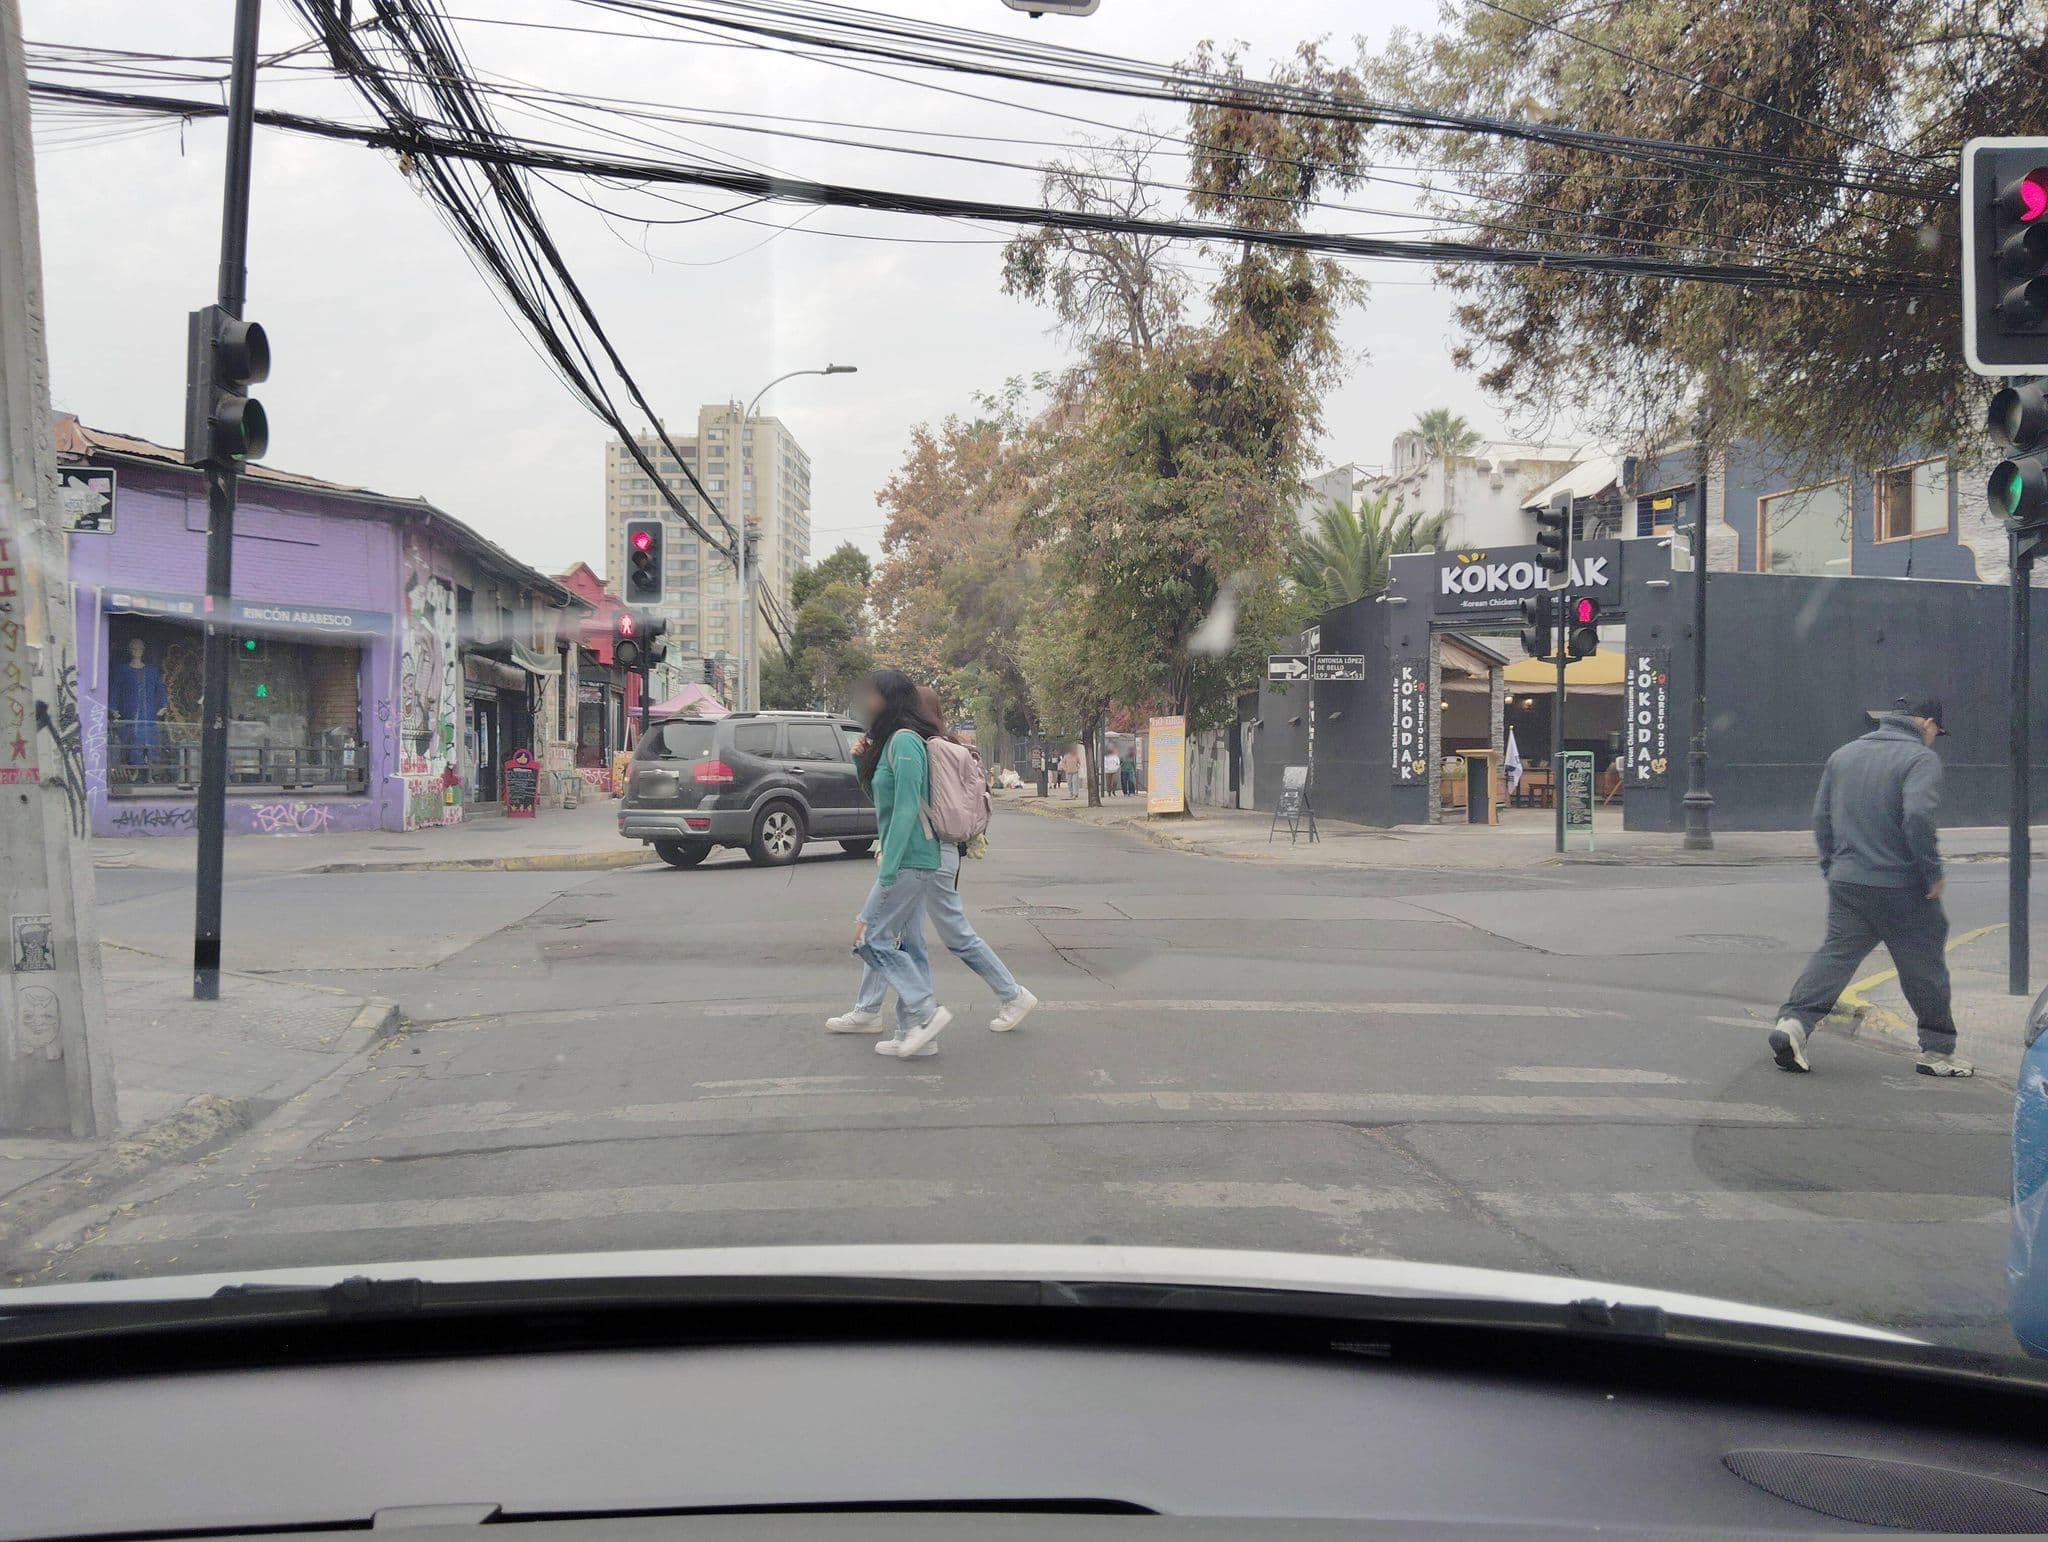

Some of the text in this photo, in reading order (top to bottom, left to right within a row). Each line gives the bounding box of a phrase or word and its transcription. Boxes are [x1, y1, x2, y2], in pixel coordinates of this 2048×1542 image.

[243, 606, 352, 626] RINCÓN ARABESCO
[1489, 597, 1518, 606] Chicken
[1344, 656, 1363, 664] LÓPEZ
[1401, 667, 1413, 779] KOKODAK
[1638, 657, 1652, 779] KOKODAK
[1657, 687, 1665, 755] LORETO 207
